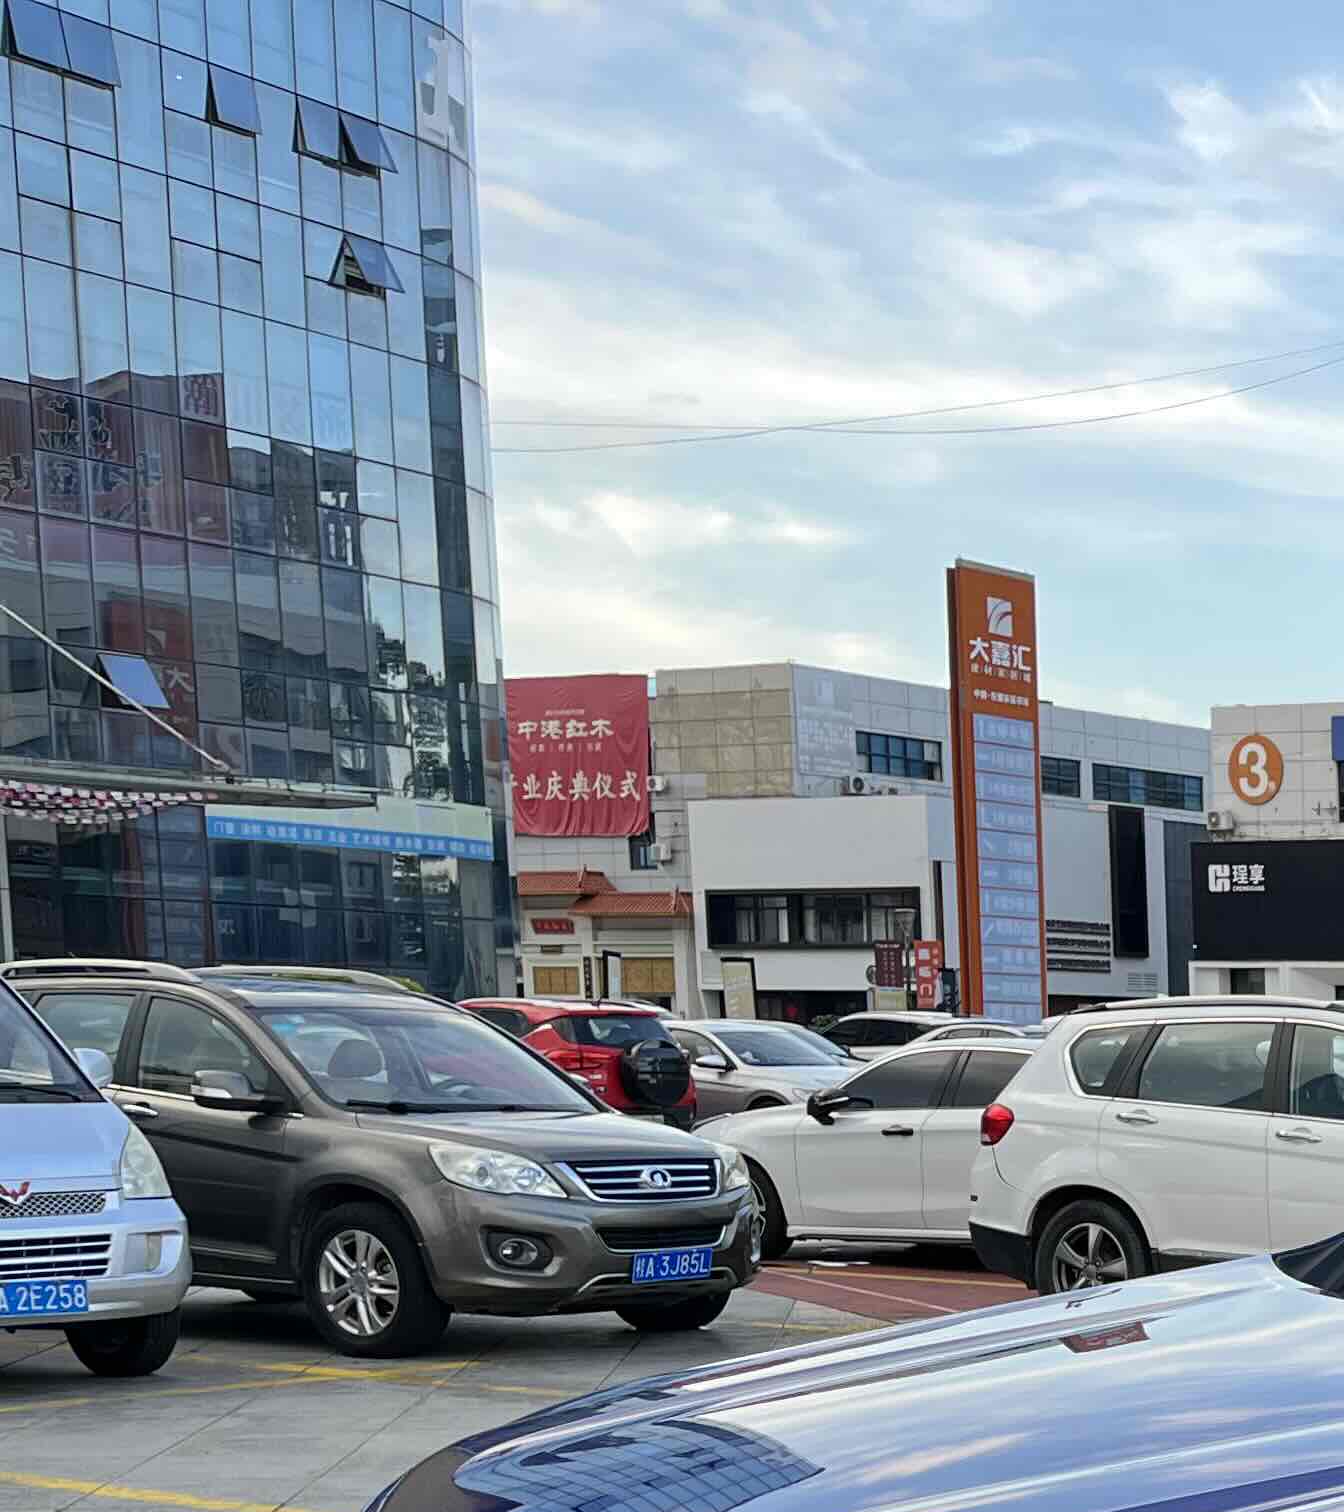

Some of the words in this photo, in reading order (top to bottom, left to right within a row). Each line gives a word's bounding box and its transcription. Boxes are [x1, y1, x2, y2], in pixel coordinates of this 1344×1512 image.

[517, 718, 615, 741] 中港红木
[1238, 742, 1269, 798] 3
